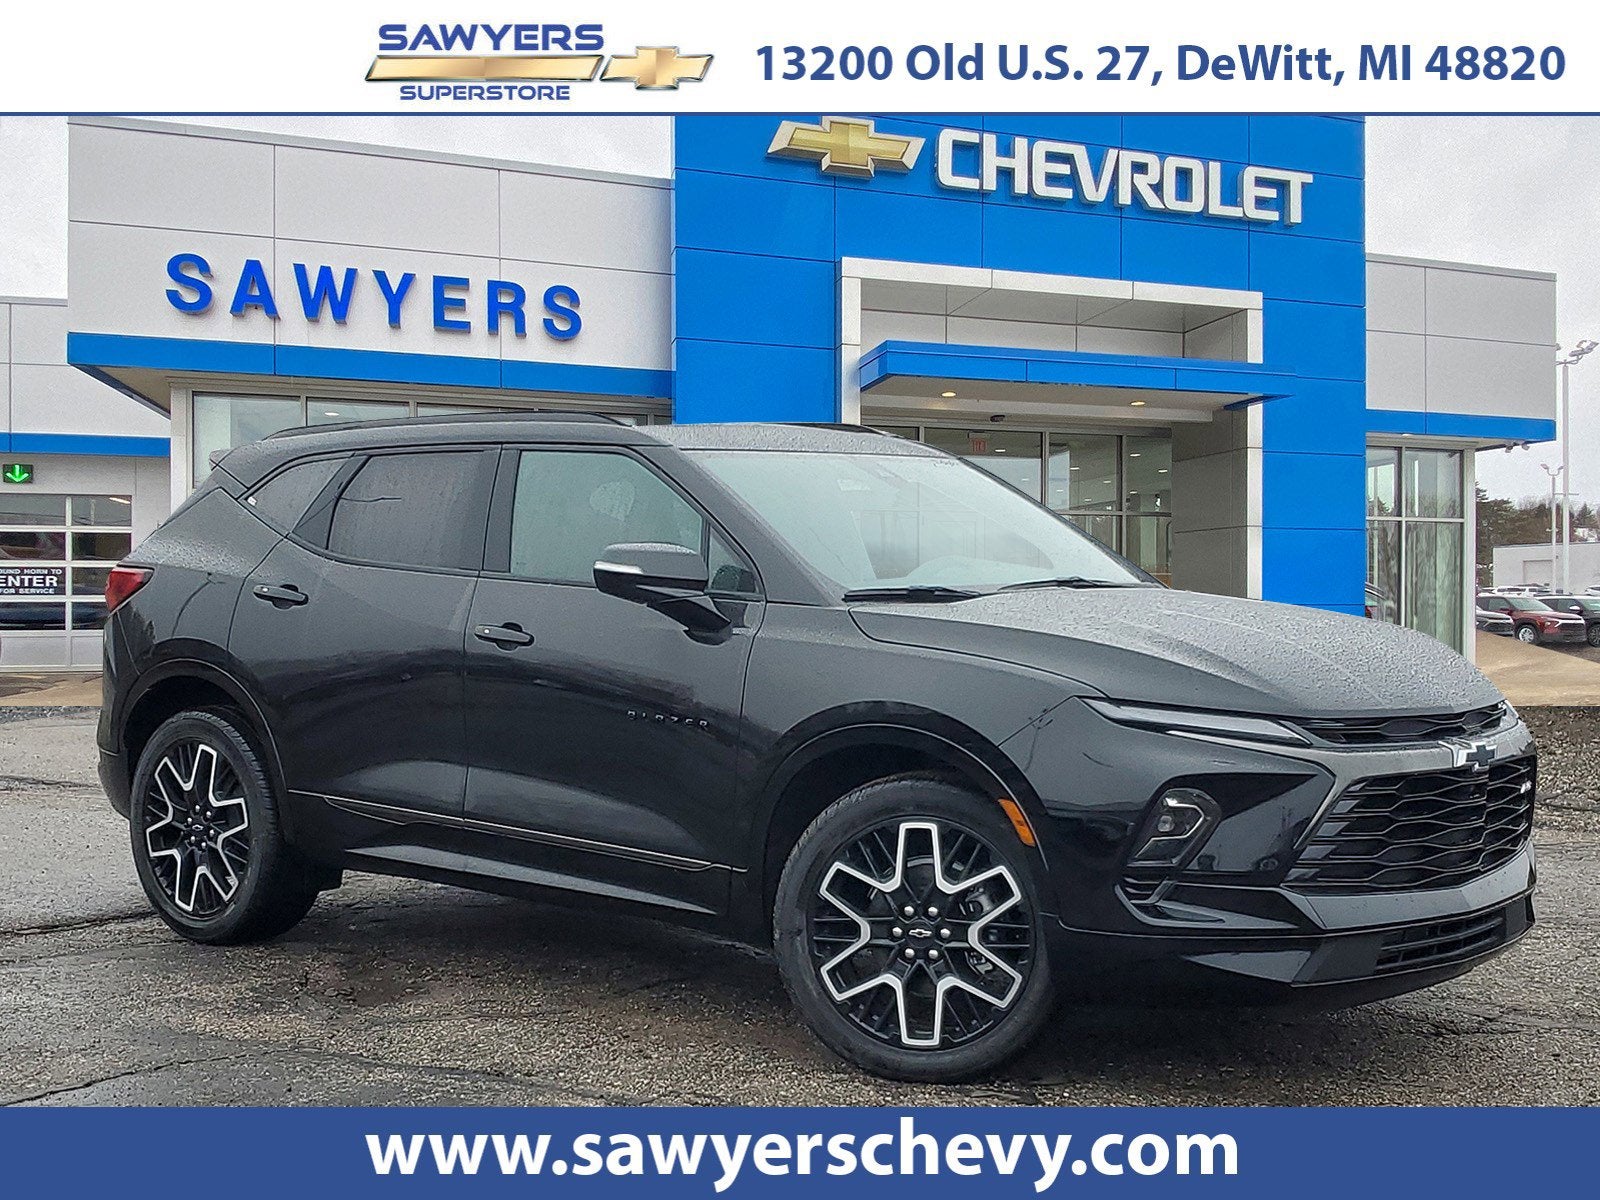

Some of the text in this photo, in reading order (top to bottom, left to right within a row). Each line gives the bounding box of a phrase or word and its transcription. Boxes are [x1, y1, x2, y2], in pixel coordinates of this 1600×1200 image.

[936, 128, 1313, 225] CHEVROLET
[165, 253, 583, 342] SAWYERS
[0, 575, 58, 587] ENTER
[627, 710, 708, 728] BLAZER
